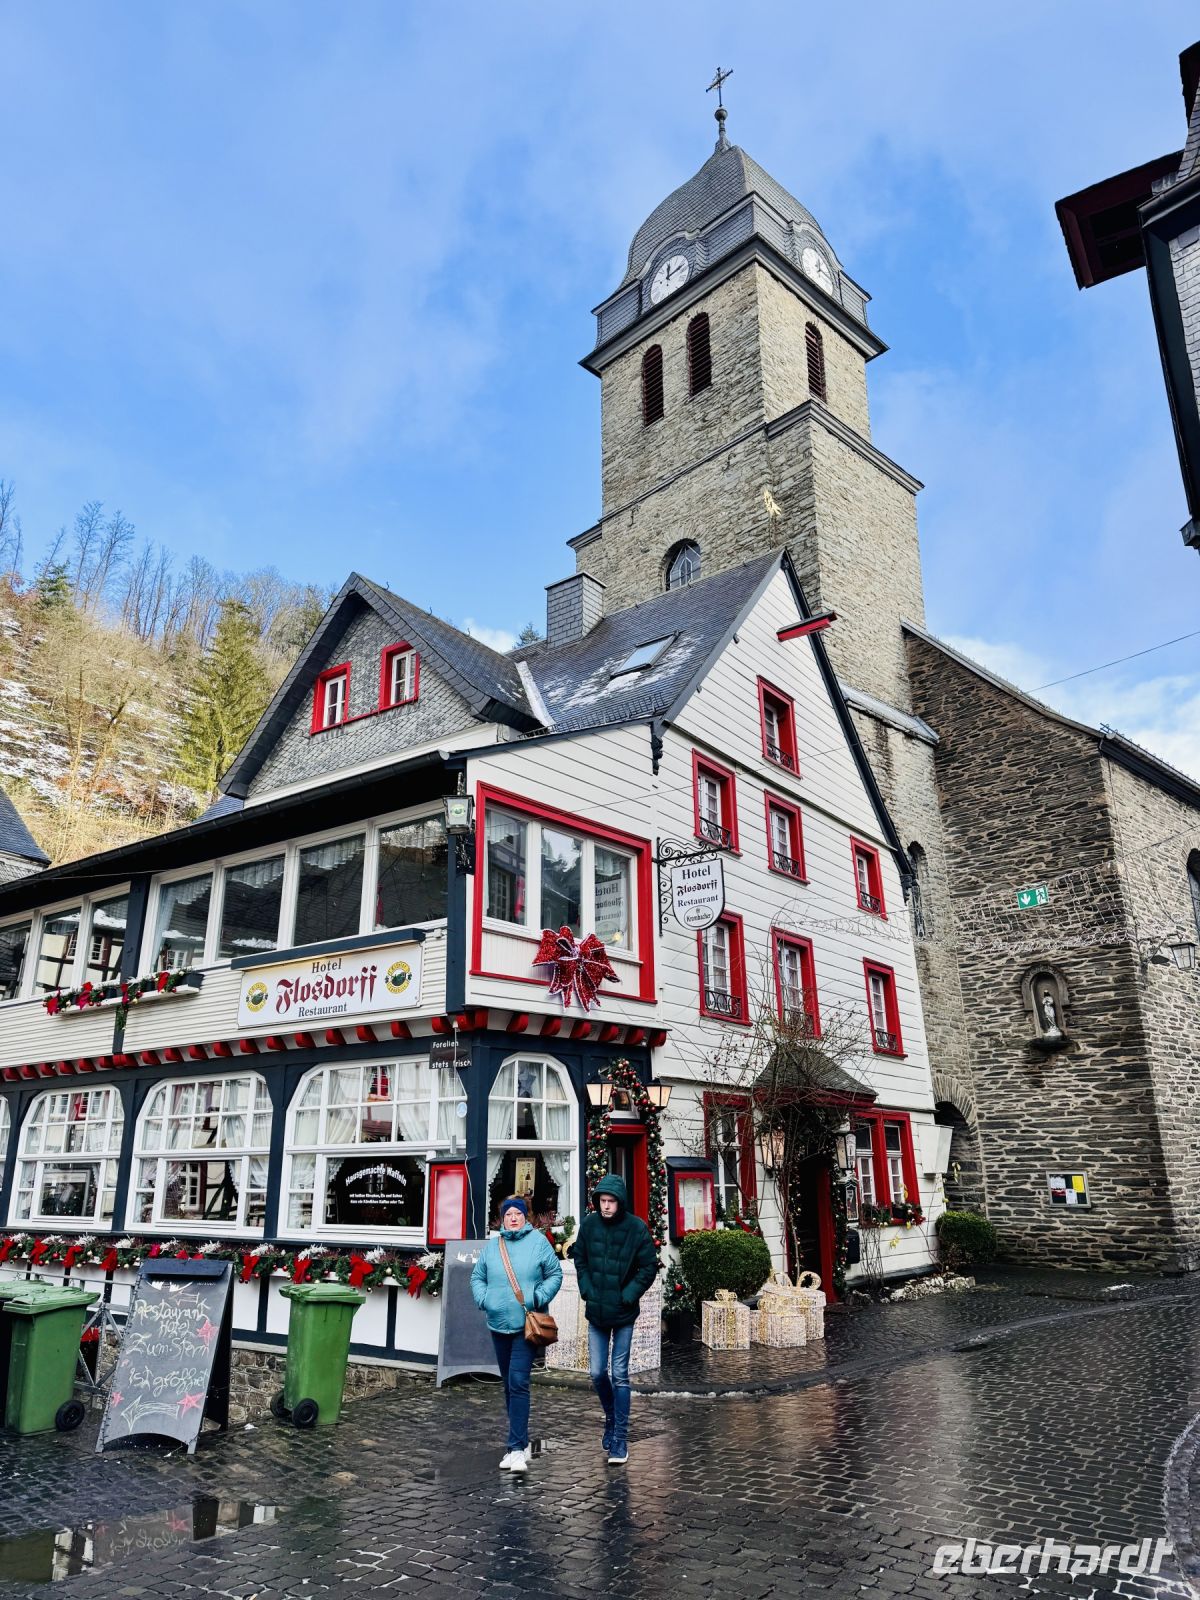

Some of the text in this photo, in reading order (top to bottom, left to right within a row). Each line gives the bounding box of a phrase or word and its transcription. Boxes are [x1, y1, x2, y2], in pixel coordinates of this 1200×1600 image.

[682, 865, 711, 880] Hotel
[677, 880, 718, 896] Flosdorff
[678, 894, 719, 907] Restaurant
[312, 958, 342, 974] Hotel
[275, 965, 378, 1015] Flosdorff
[298, 1002, 348, 1017] Restaurant
[432, 1061, 449, 1069] stets
[131, 1299, 211, 1325] Restaurant
[159, 1319, 191, 1338] Hotel
[171, 1337, 210, 1360] Stern
